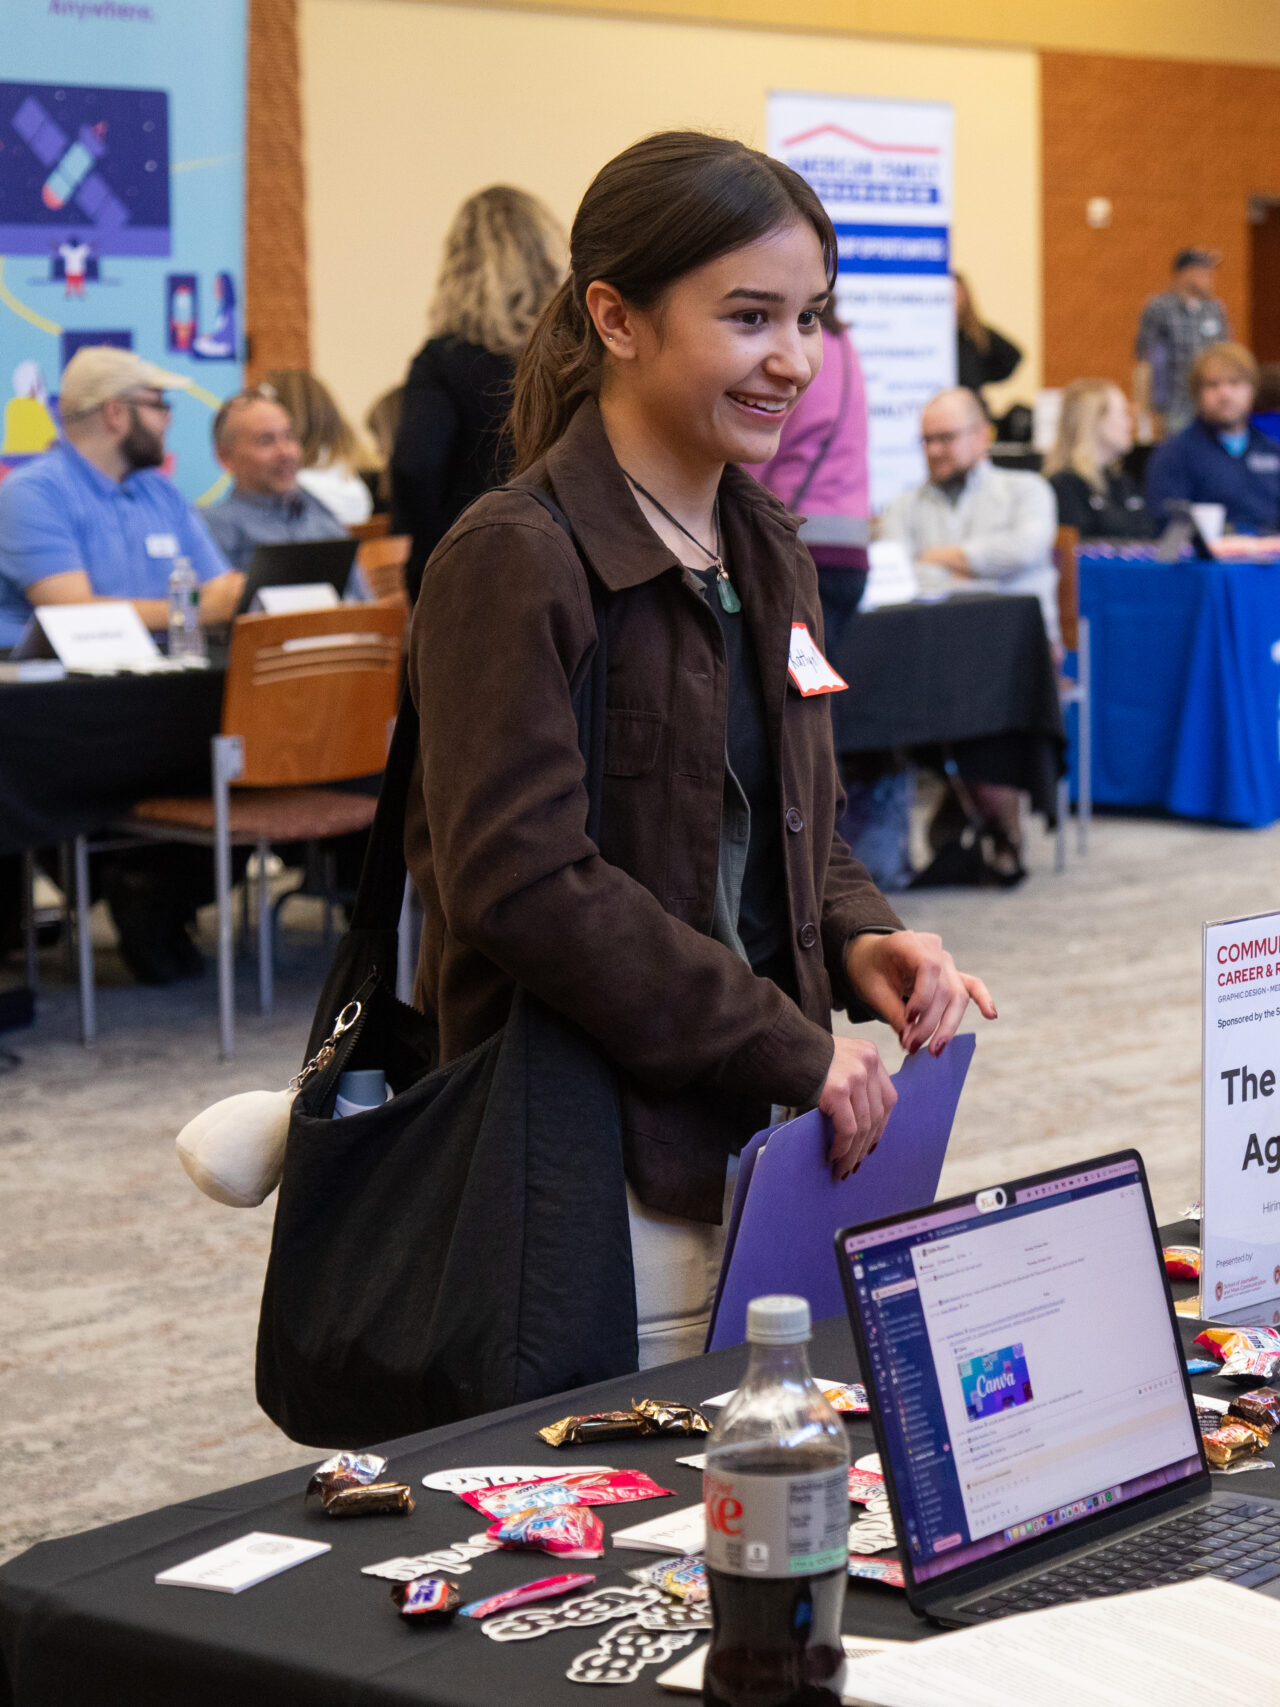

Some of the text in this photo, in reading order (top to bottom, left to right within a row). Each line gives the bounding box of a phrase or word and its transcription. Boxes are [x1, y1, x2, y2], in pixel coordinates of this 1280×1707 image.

[1217, 965, 1264, 987] CAREER
[1266, 963, 1273, 978] &
[1217, 990, 1245, 1004] GRAPHIC
[1244, 986, 1267, 998] DESIGN
[1217, 1014, 1254, 1029] Sponsored
[1254, 1012, 1263, 1022] by
[1264, 1009, 1275, 1018] the
[1220, 1064, 1276, 1106] The
[1215, 1253, 1245, 1269] Presented
[976, 1371, 1016, 1399] Canva
